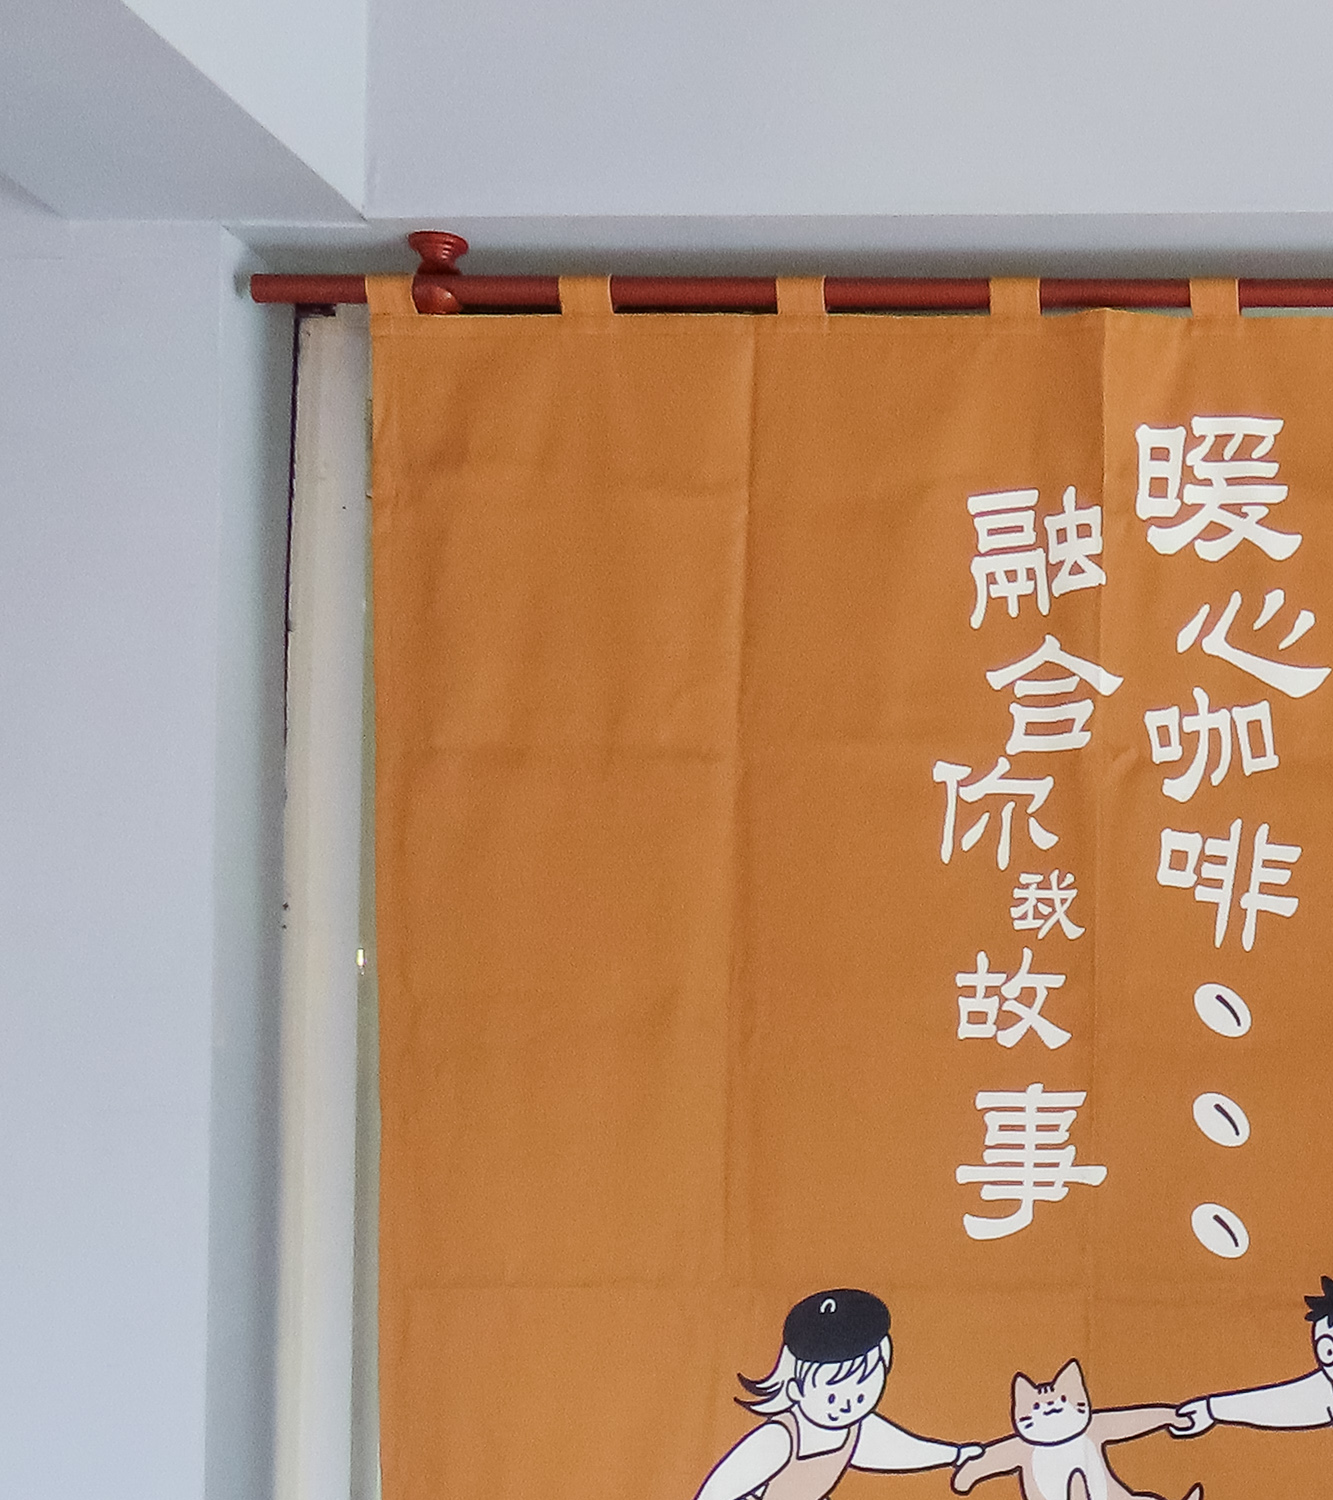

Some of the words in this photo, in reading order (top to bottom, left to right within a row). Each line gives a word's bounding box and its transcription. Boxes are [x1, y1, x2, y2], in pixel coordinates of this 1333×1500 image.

[933, 486, 1124, 1241] 融合你我故事
[1134, 415, 1332, 952] 暖心咖啡
